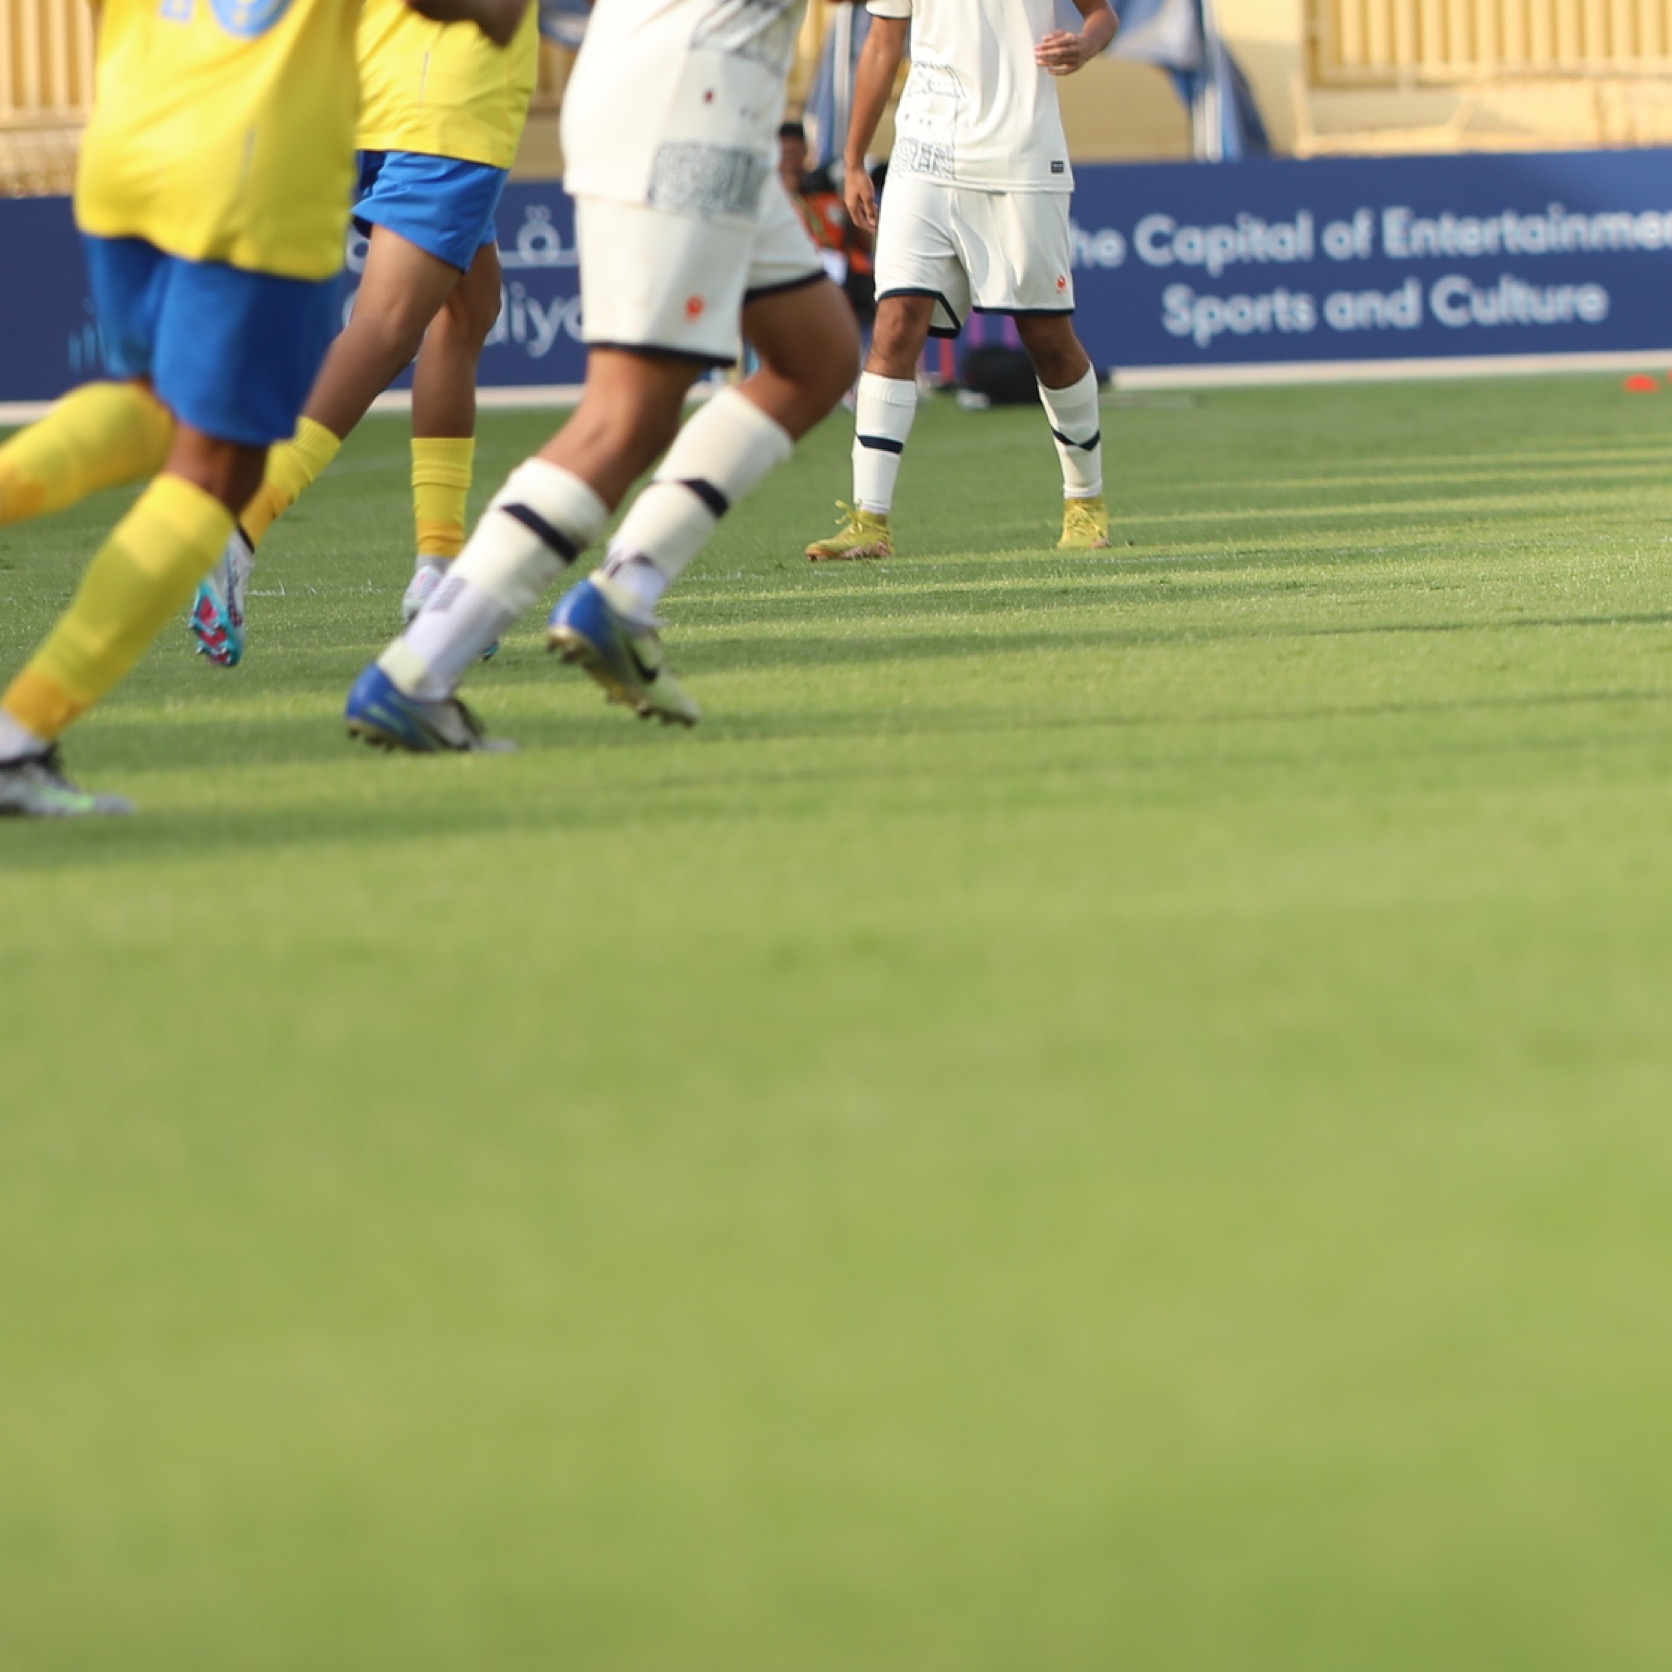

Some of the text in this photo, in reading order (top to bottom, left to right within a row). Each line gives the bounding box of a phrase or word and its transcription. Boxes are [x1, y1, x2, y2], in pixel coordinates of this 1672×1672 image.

[1070, 217, 1126, 270] he
[1133, 208, 1315, 278] Capital
[1321, 206, 1376, 261] of
[1161, 274, 1610, 349] Sports and Culture
